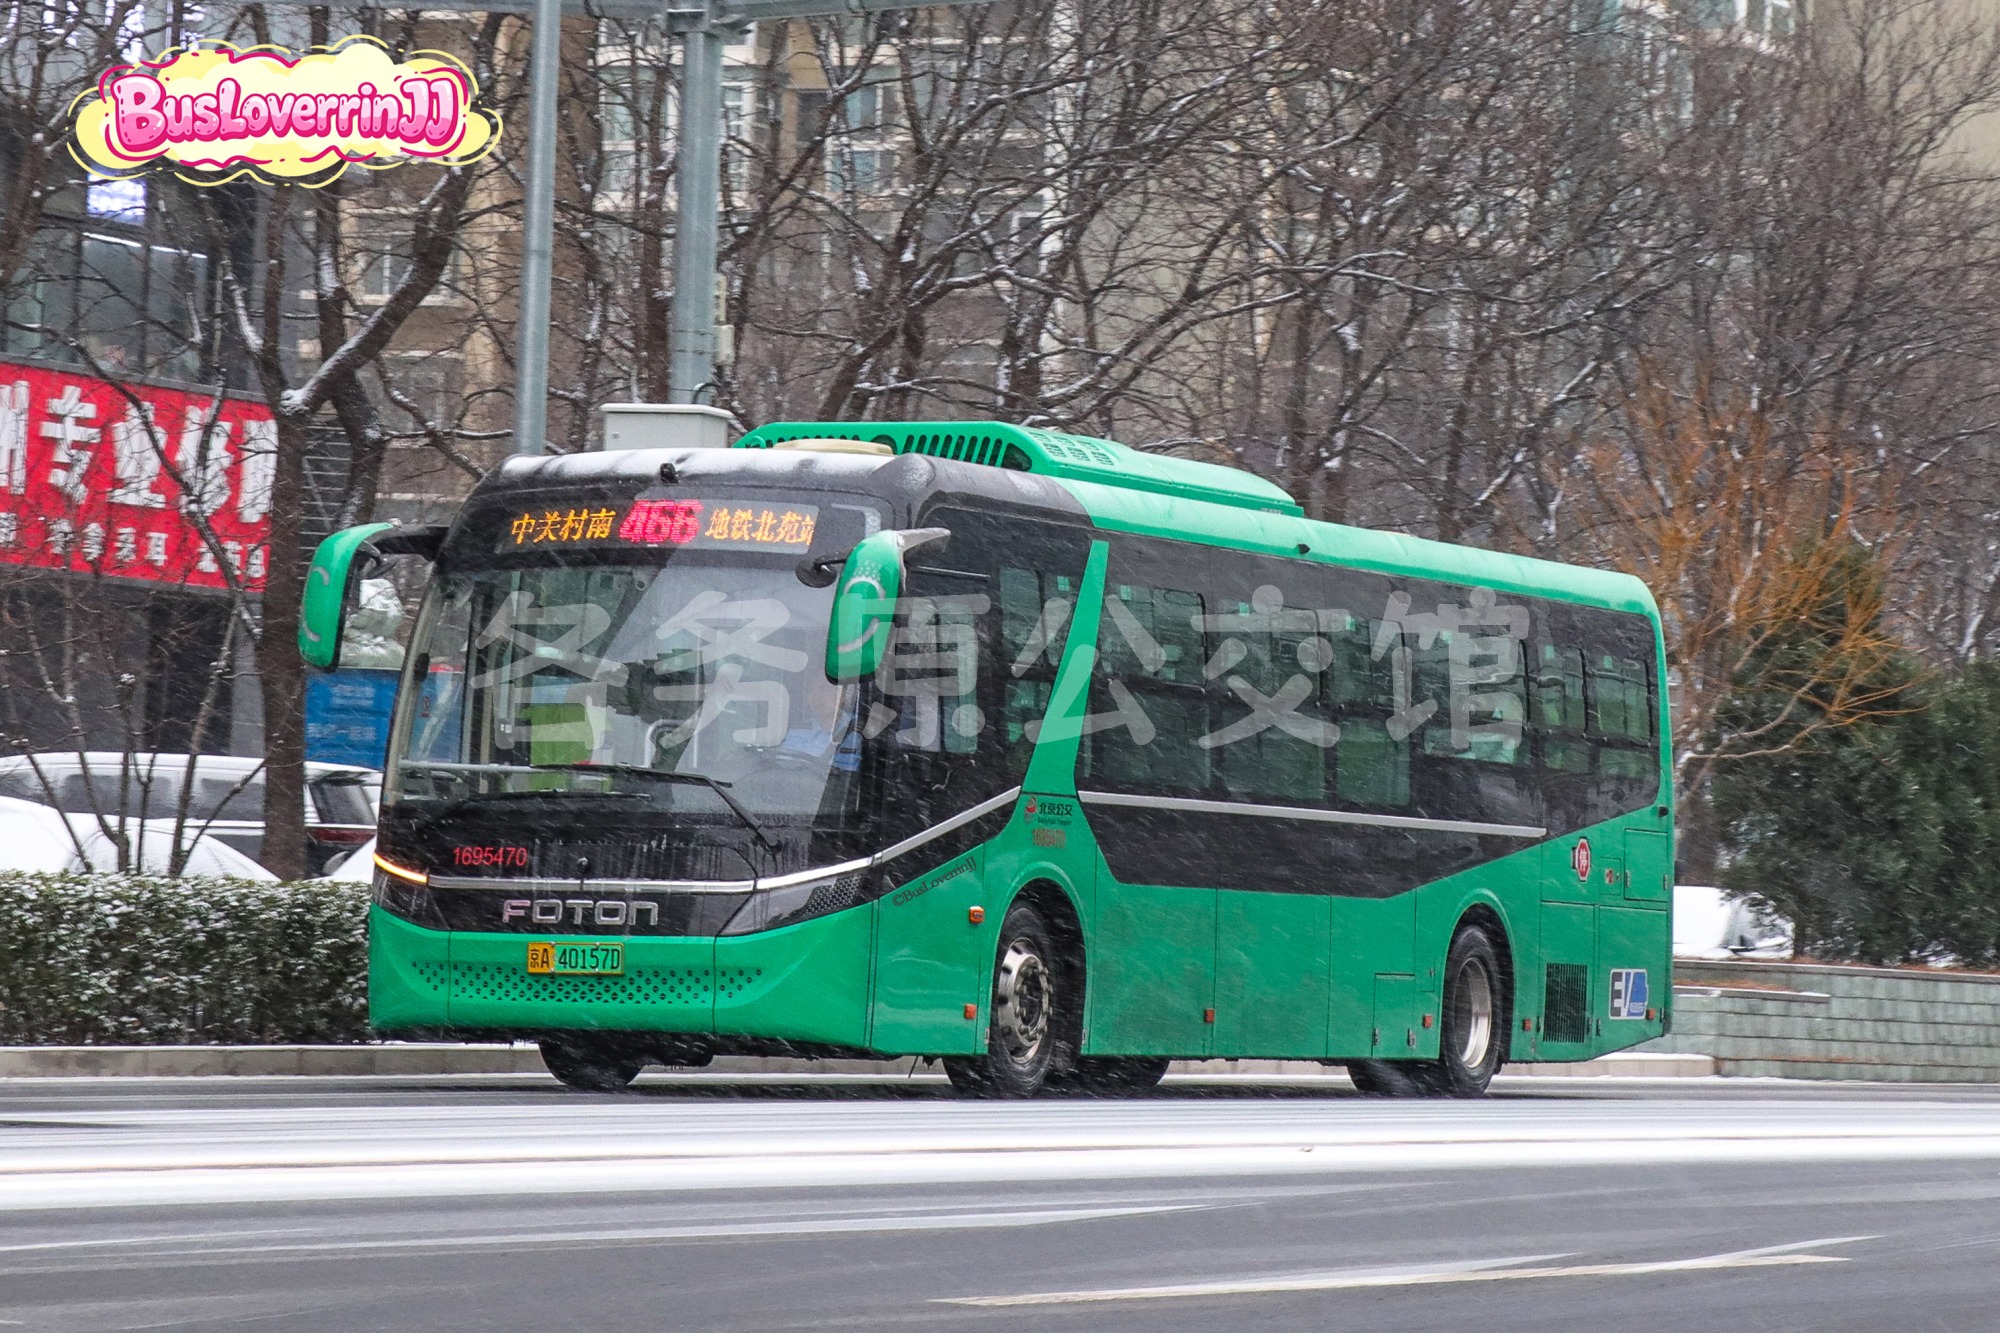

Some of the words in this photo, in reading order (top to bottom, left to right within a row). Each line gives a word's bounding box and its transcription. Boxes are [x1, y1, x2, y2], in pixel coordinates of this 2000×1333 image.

[511, 507, 617, 545] 中关村南
[619, 499, 704, 545] 466
[1039, 802, 1073, 816] 北京公交
[453, 847, 528, 866] 1695470
[502, 899, 659, 926] FOTON
